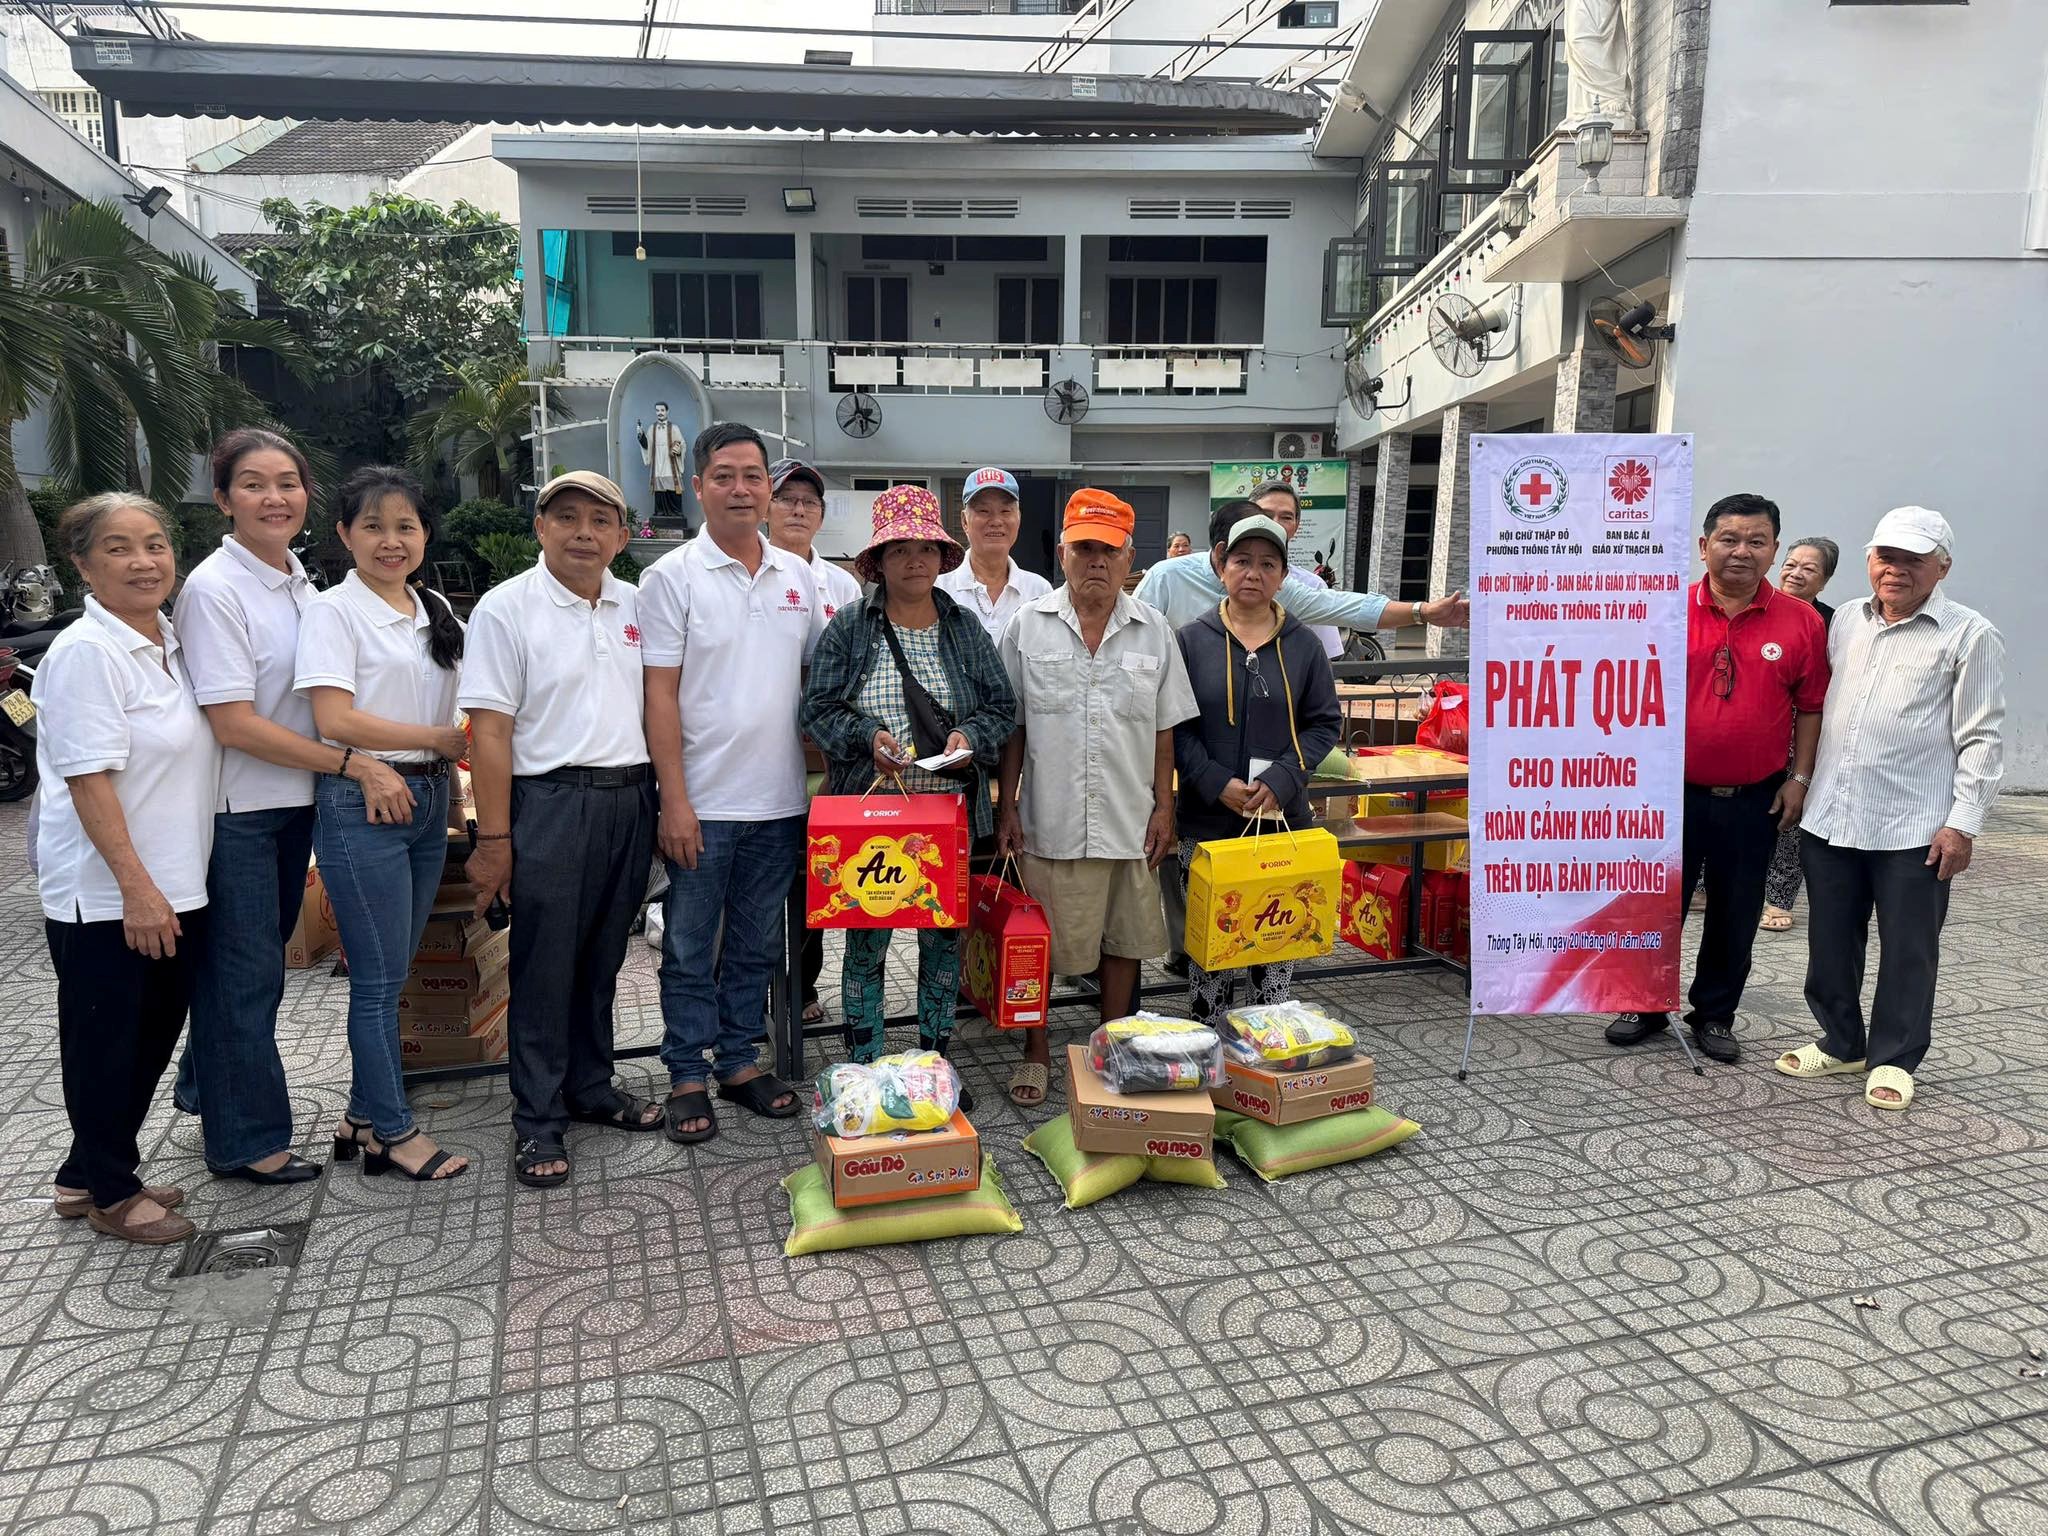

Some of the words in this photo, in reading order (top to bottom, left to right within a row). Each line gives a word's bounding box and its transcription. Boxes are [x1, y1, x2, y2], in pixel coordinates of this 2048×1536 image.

[1608, 508, 1649, 520] caritas
[1499, 530, 1512, 542] HỘI
[1515, 530, 1534, 540] CHỮ
[1534, 529, 1556, 542] THẬP
[1558, 528, 1570, 540] ĐỎ
[1606, 531, 1622, 540] BAN
[1624, 530, 1639, 540] BÁC
[1641, 529, 1650, 540] ÁI
[1486, 544, 1518, 556] PHƯỜNG
[1522, 544, 1549, 555] THÔNG
[1552, 544, 1566, 554] TÂY
[1568, 544, 1582, 556] HỘI
[1592, 544, 1611, 554] GIÁO
[1613, 544, 1624, 554] XỨ
[1625, 544, 1650, 556] THẠCH
[1652, 543, 1664, 554] ĐÀ
[1478, 572, 1492, 596] HỘI
[1494, 572, 1510, 592] CHỮ
[1512, 572, 1534, 596] THẬP
[1536, 570, 1548, 592] ĐỎ
[1556, 575, 1575, 592] BAN
[1576, 572, 1593, 592] BÁC
[1595, 571, 1603, 591] ÁI
[1605, 571, 1624, 591] GIÁO
[1625, 571, 1637, 591] XỨ
[1638, 574, 1665, 595] THẠCH
[1666, 571, 1679, 591] ĐÀ
[1506, 600, 1557, 620] PHƯỜNG
[1561, 600, 1601, 620] THÔNG
[1604, 600, 1625, 620] TÂY
[1628, 600, 1647, 623] HỘI
[1485, 644, 1582, 728] PHÁT
[1592, 644, 1666, 736] QUÀ
[1508, 757, 1554, 788] CHO
[1561, 752, 1637, 788] NHỮNG
[1485, 804, 1525, 841] HOÀN
[1531, 800, 1576, 840] CẢNH
[1582, 804, 1611, 840] KHÓ
[1616, 804, 1664, 840] KHĂN
[856, 850, 907, 888] An
[1268, 860, 1291, 868] ORION
[1484, 857, 1521, 893] TRÊN
[1526, 863, 1553, 898] ĐỊA
[1558, 857, 1591, 892] BÀN
[1596, 854, 1665, 893] PHƯỜNG
[1254, 898, 1297, 932] An
[1359, 903, 1378, 927] An
[1487, 933, 1511, 954] Thông
[1513, 932, 1527, 953] Tây
[1529, 932, 1544, 952] Hội,
[1547, 933, 1568, 953] ngày
[1569, 932, 1579, 948] 20
[1581, 930, 1604, 953] tháng
[1607, 932, 1617, 949] 01
[1620, 931, 1640, 949] năm
[1640, 932, 1662, 949] 2026
[293, 950, 301, 961] 6
